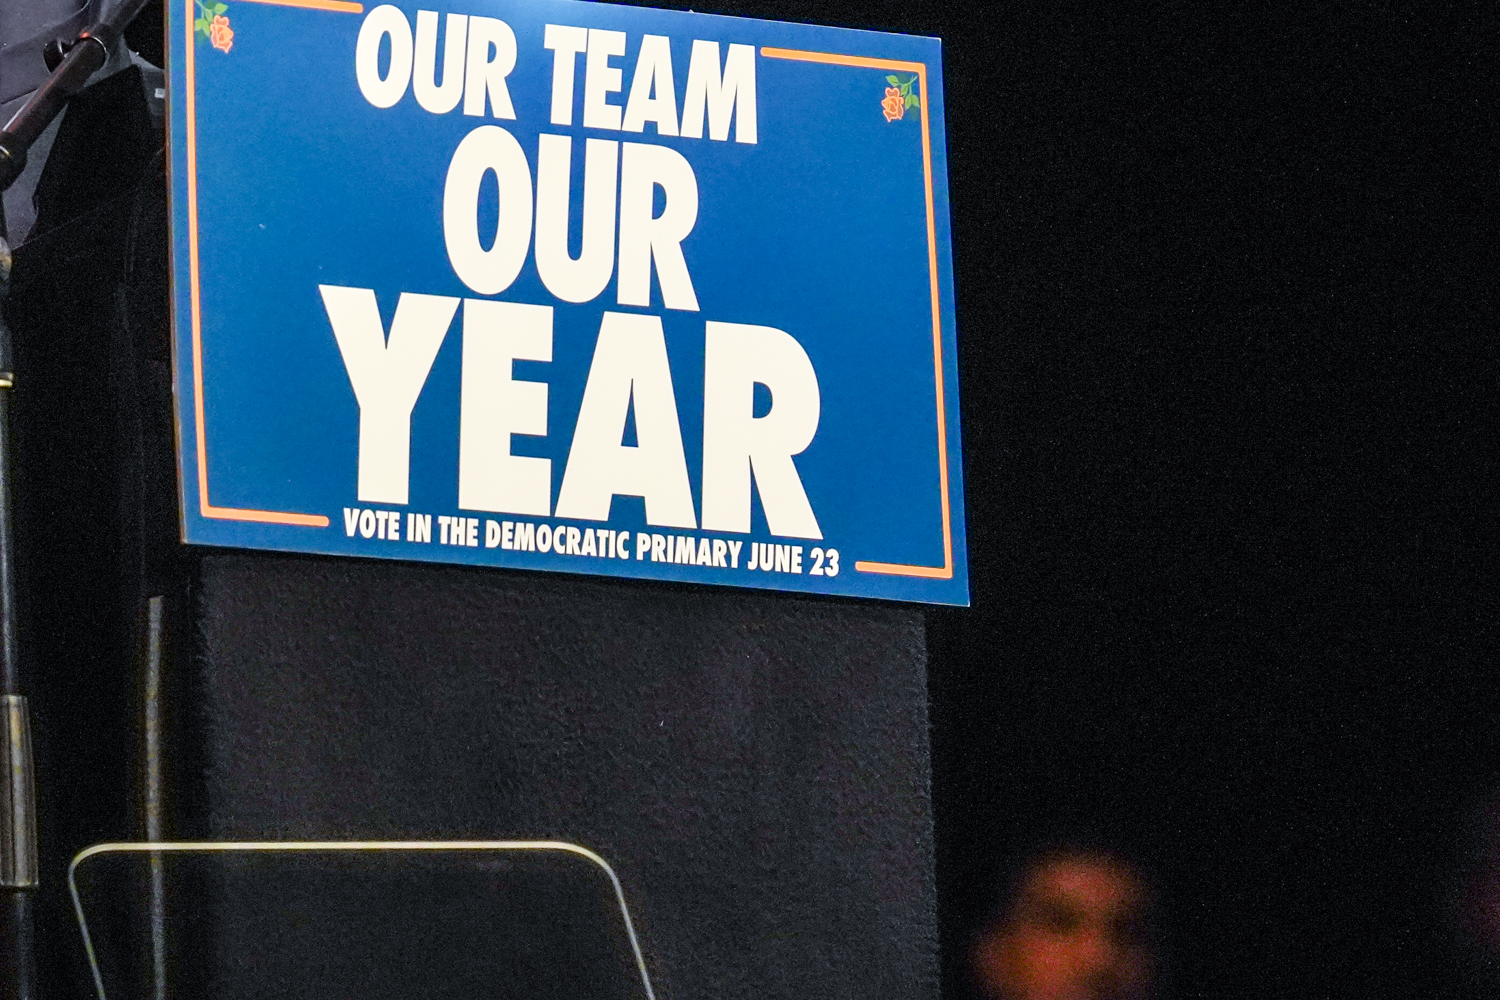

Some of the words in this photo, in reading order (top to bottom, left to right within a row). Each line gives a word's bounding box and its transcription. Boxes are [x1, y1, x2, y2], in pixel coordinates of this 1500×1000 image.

[356, 4, 517, 120] OUR
[544, 23, 757, 144] TEAM
[443, 125, 700, 311] OUR
[319, 284, 823, 540] YEAR
[344, 508, 400, 540] VOTE
[407, 513, 431, 543] IN
[438, 516, 478, 546] THE
[485, 520, 629, 559] DEMOCRATIC
[636, 533, 742, 568] PRIMARY
[748, 543, 802, 573] JUNE
[809, 547, 839, 577] 23
